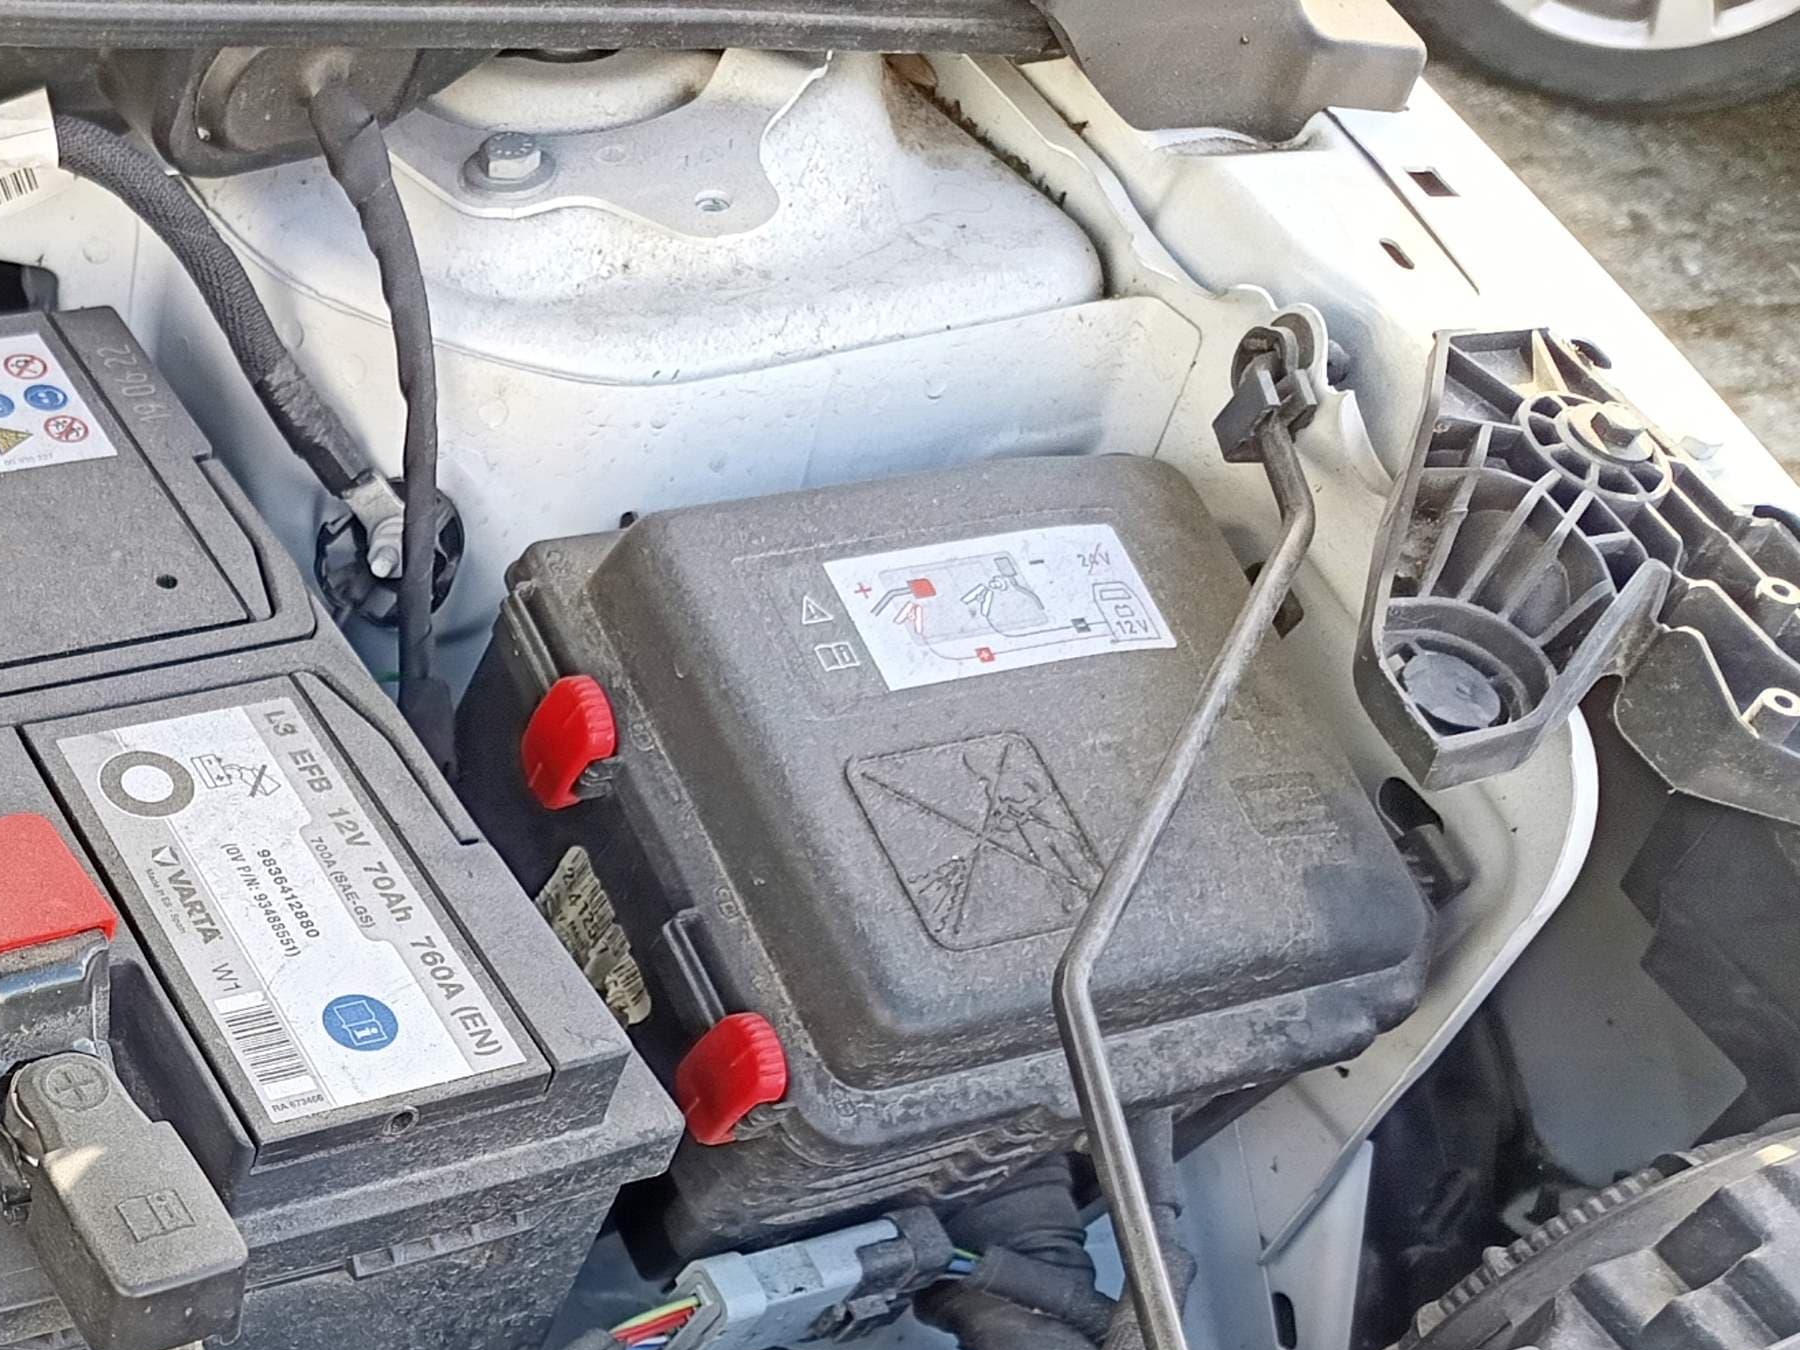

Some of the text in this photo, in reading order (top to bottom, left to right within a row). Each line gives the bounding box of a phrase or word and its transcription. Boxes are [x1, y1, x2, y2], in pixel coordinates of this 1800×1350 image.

[1114, 618, 1149, 637] 12V
[167, 868, 222, 945] VARTA
[237, 865, 261, 891] P/N:
[253, 892, 302, 958] 93488551)
[257, 848, 320, 939] 9836412880
[263, 709, 504, 1056] L3 EFB 12V 70Ah 760A (EN)
[310, 836, 377, 930] 700A (SAE-GS)
[211, 962, 243, 992] W1
